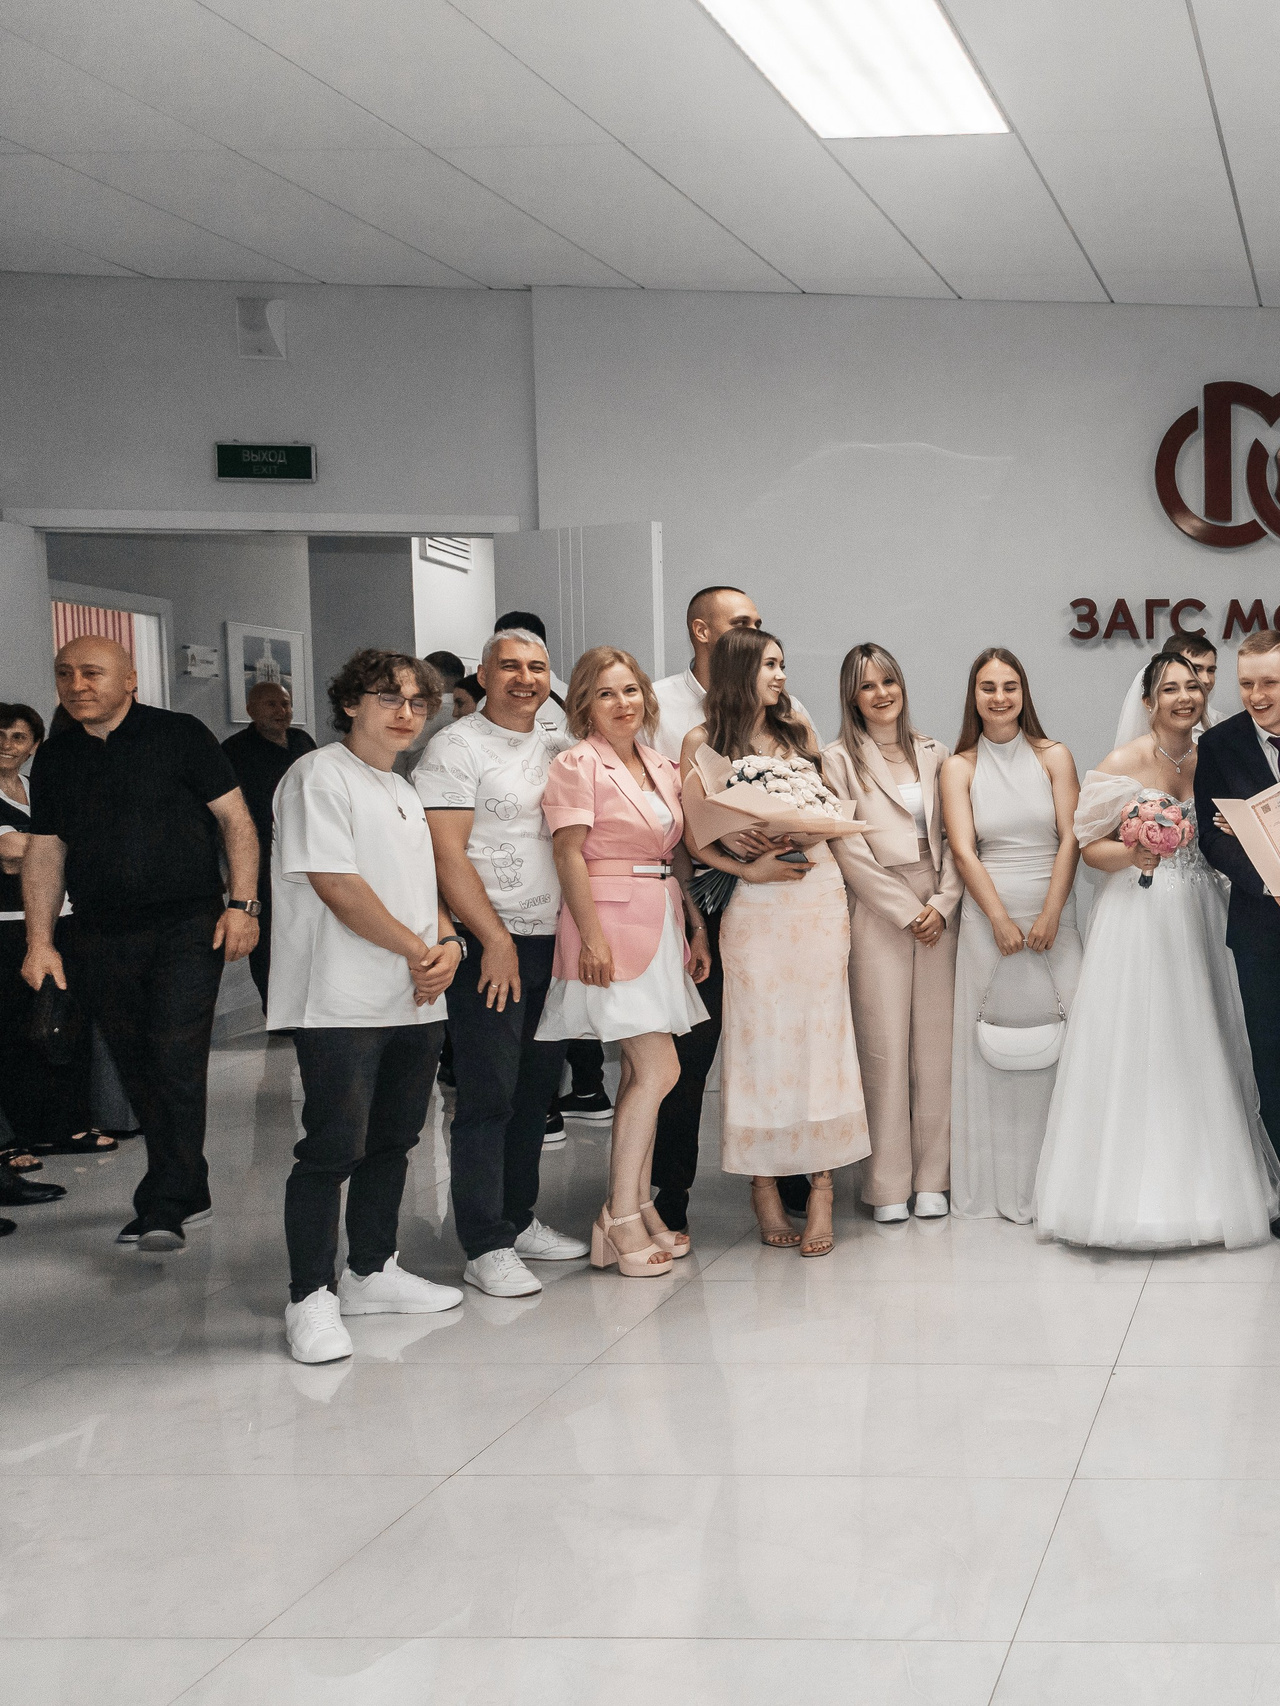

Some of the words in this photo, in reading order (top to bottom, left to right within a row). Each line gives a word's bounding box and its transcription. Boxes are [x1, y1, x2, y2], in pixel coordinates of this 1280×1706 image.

[242, 449, 287, 464] ВЫХОД
[253, 465, 278, 474] EXIT
[1068, 597, 1207, 640] ЗАГС
[518, 893, 551, 910] WAVES
